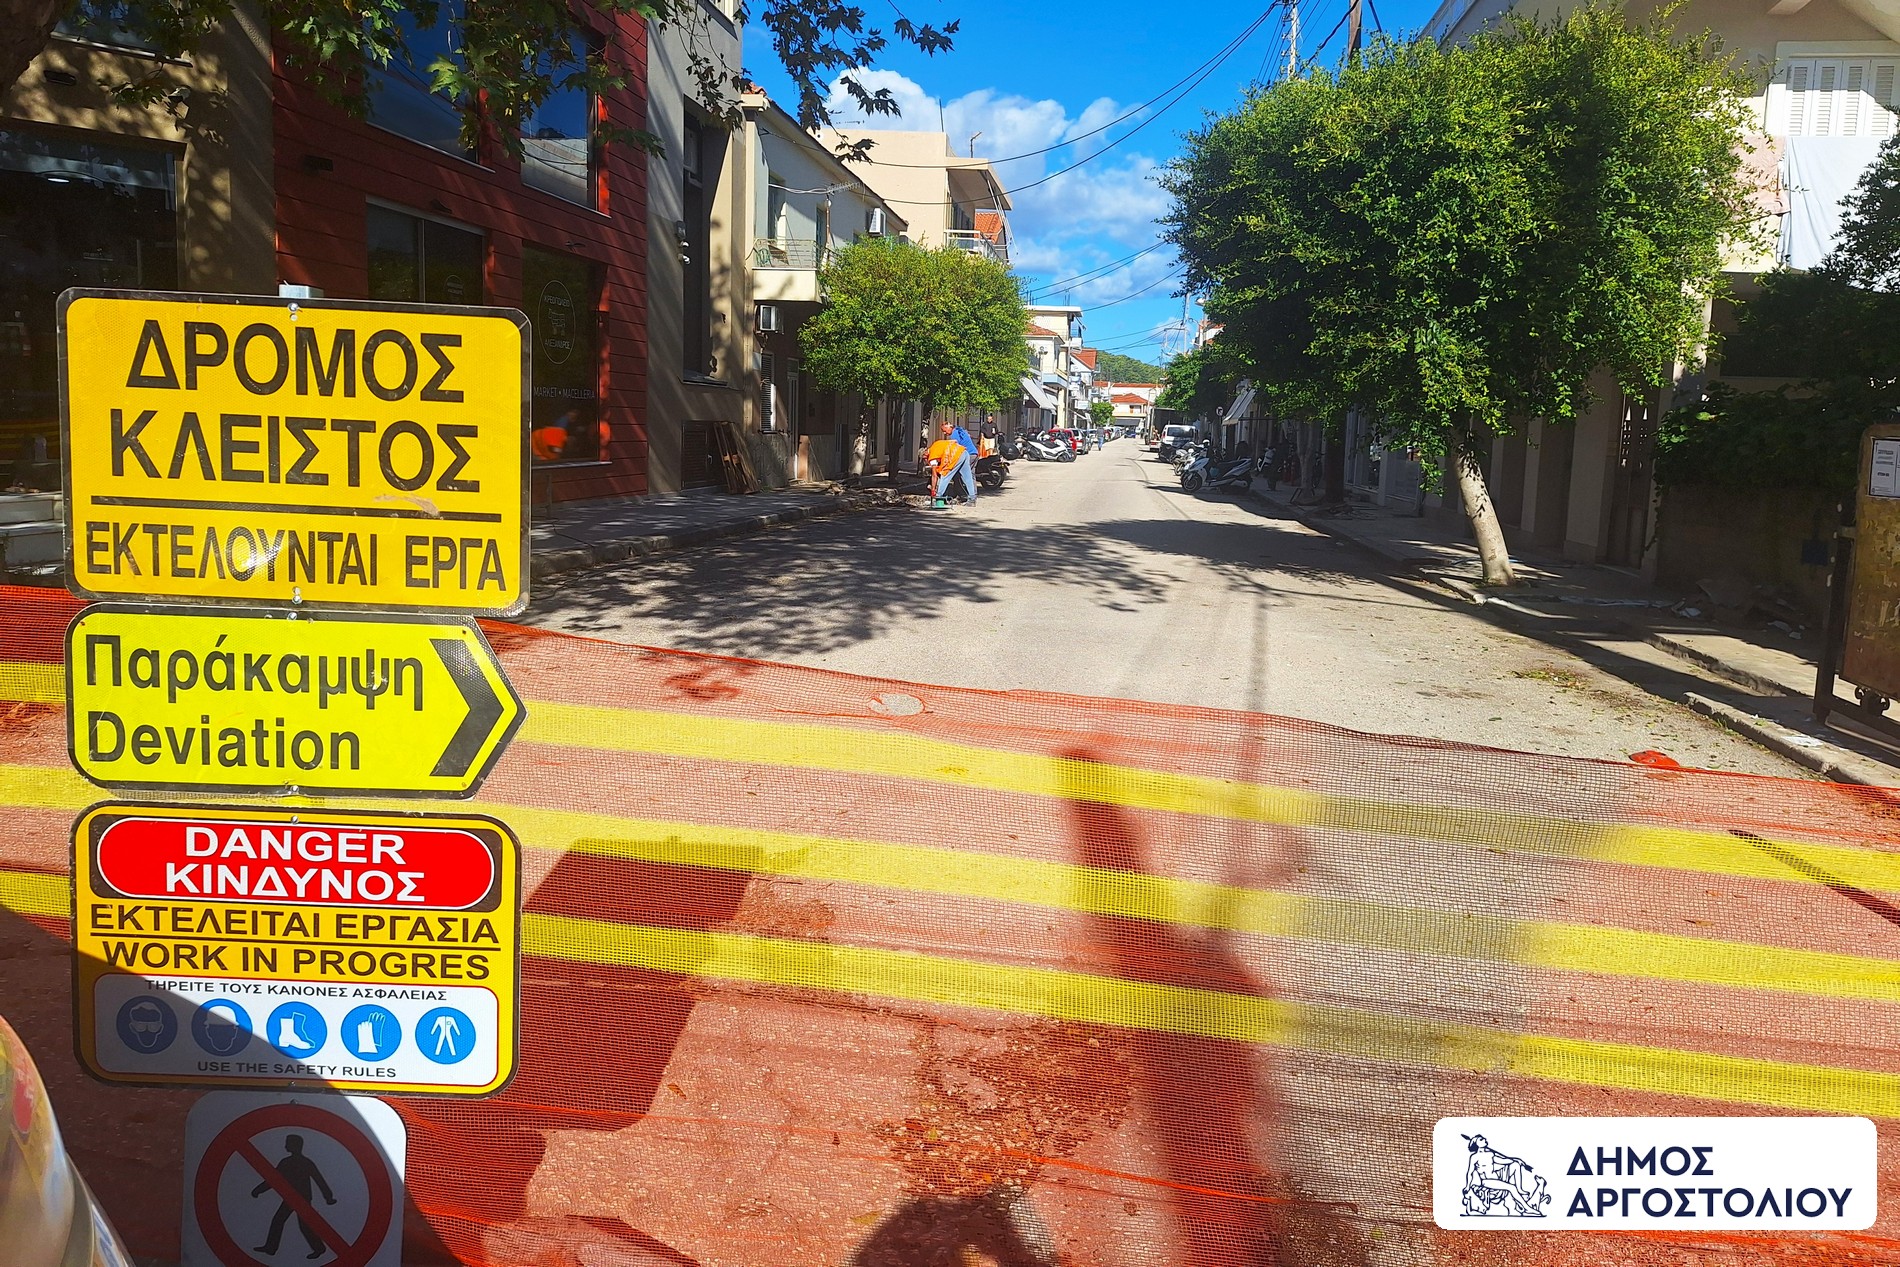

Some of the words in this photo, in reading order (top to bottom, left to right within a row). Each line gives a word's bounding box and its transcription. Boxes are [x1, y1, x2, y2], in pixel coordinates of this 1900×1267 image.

[126, 319, 464, 403] ΔΡΟΜΟΣ
[533, 386, 557, 398] MARKET
[562, 388, 596, 400] MACELLERIA
[110, 408, 481, 493] ΚΛΕΙΣΤΟΣ
[86, 521, 377, 587] ΕΚΤΕΛΟΥΝΤΑΙ
[404, 534, 507, 591] ΕΡΓΑ
[85, 633, 423, 711] Παράκαμψη
[88, 711, 360, 771] Deviation
[186, 826, 405, 865] DANGER
[166, 863, 426, 902] ΚΙΝΔΥΝΟΣ
[91, 904, 321, 938] ΕΚΤΕΛΕΙΤΑΙ
[336, 912, 500, 944] ΕΡΓΑΣΙΑ
[102, 941, 229, 971] WORK
[242, 946, 278, 973] IN
[294, 949, 490, 980] PROGRES
[145, 979, 215, 993] ΤΗΡΕΙΤΕ
[219, 982, 263, 995] ΤΟΥΣ
[267, 984, 348, 998] ΚΑΝΟΝΕΣ
[352, 987, 447, 1001] ΑΣΦΑΛΕΙΑΣ
[197, 1061, 231, 1073] USE
[235, 1062, 269, 1074] THE
[273, 1063, 338, 1076] SAFETY
[342, 1066, 397, 1078] RULES
